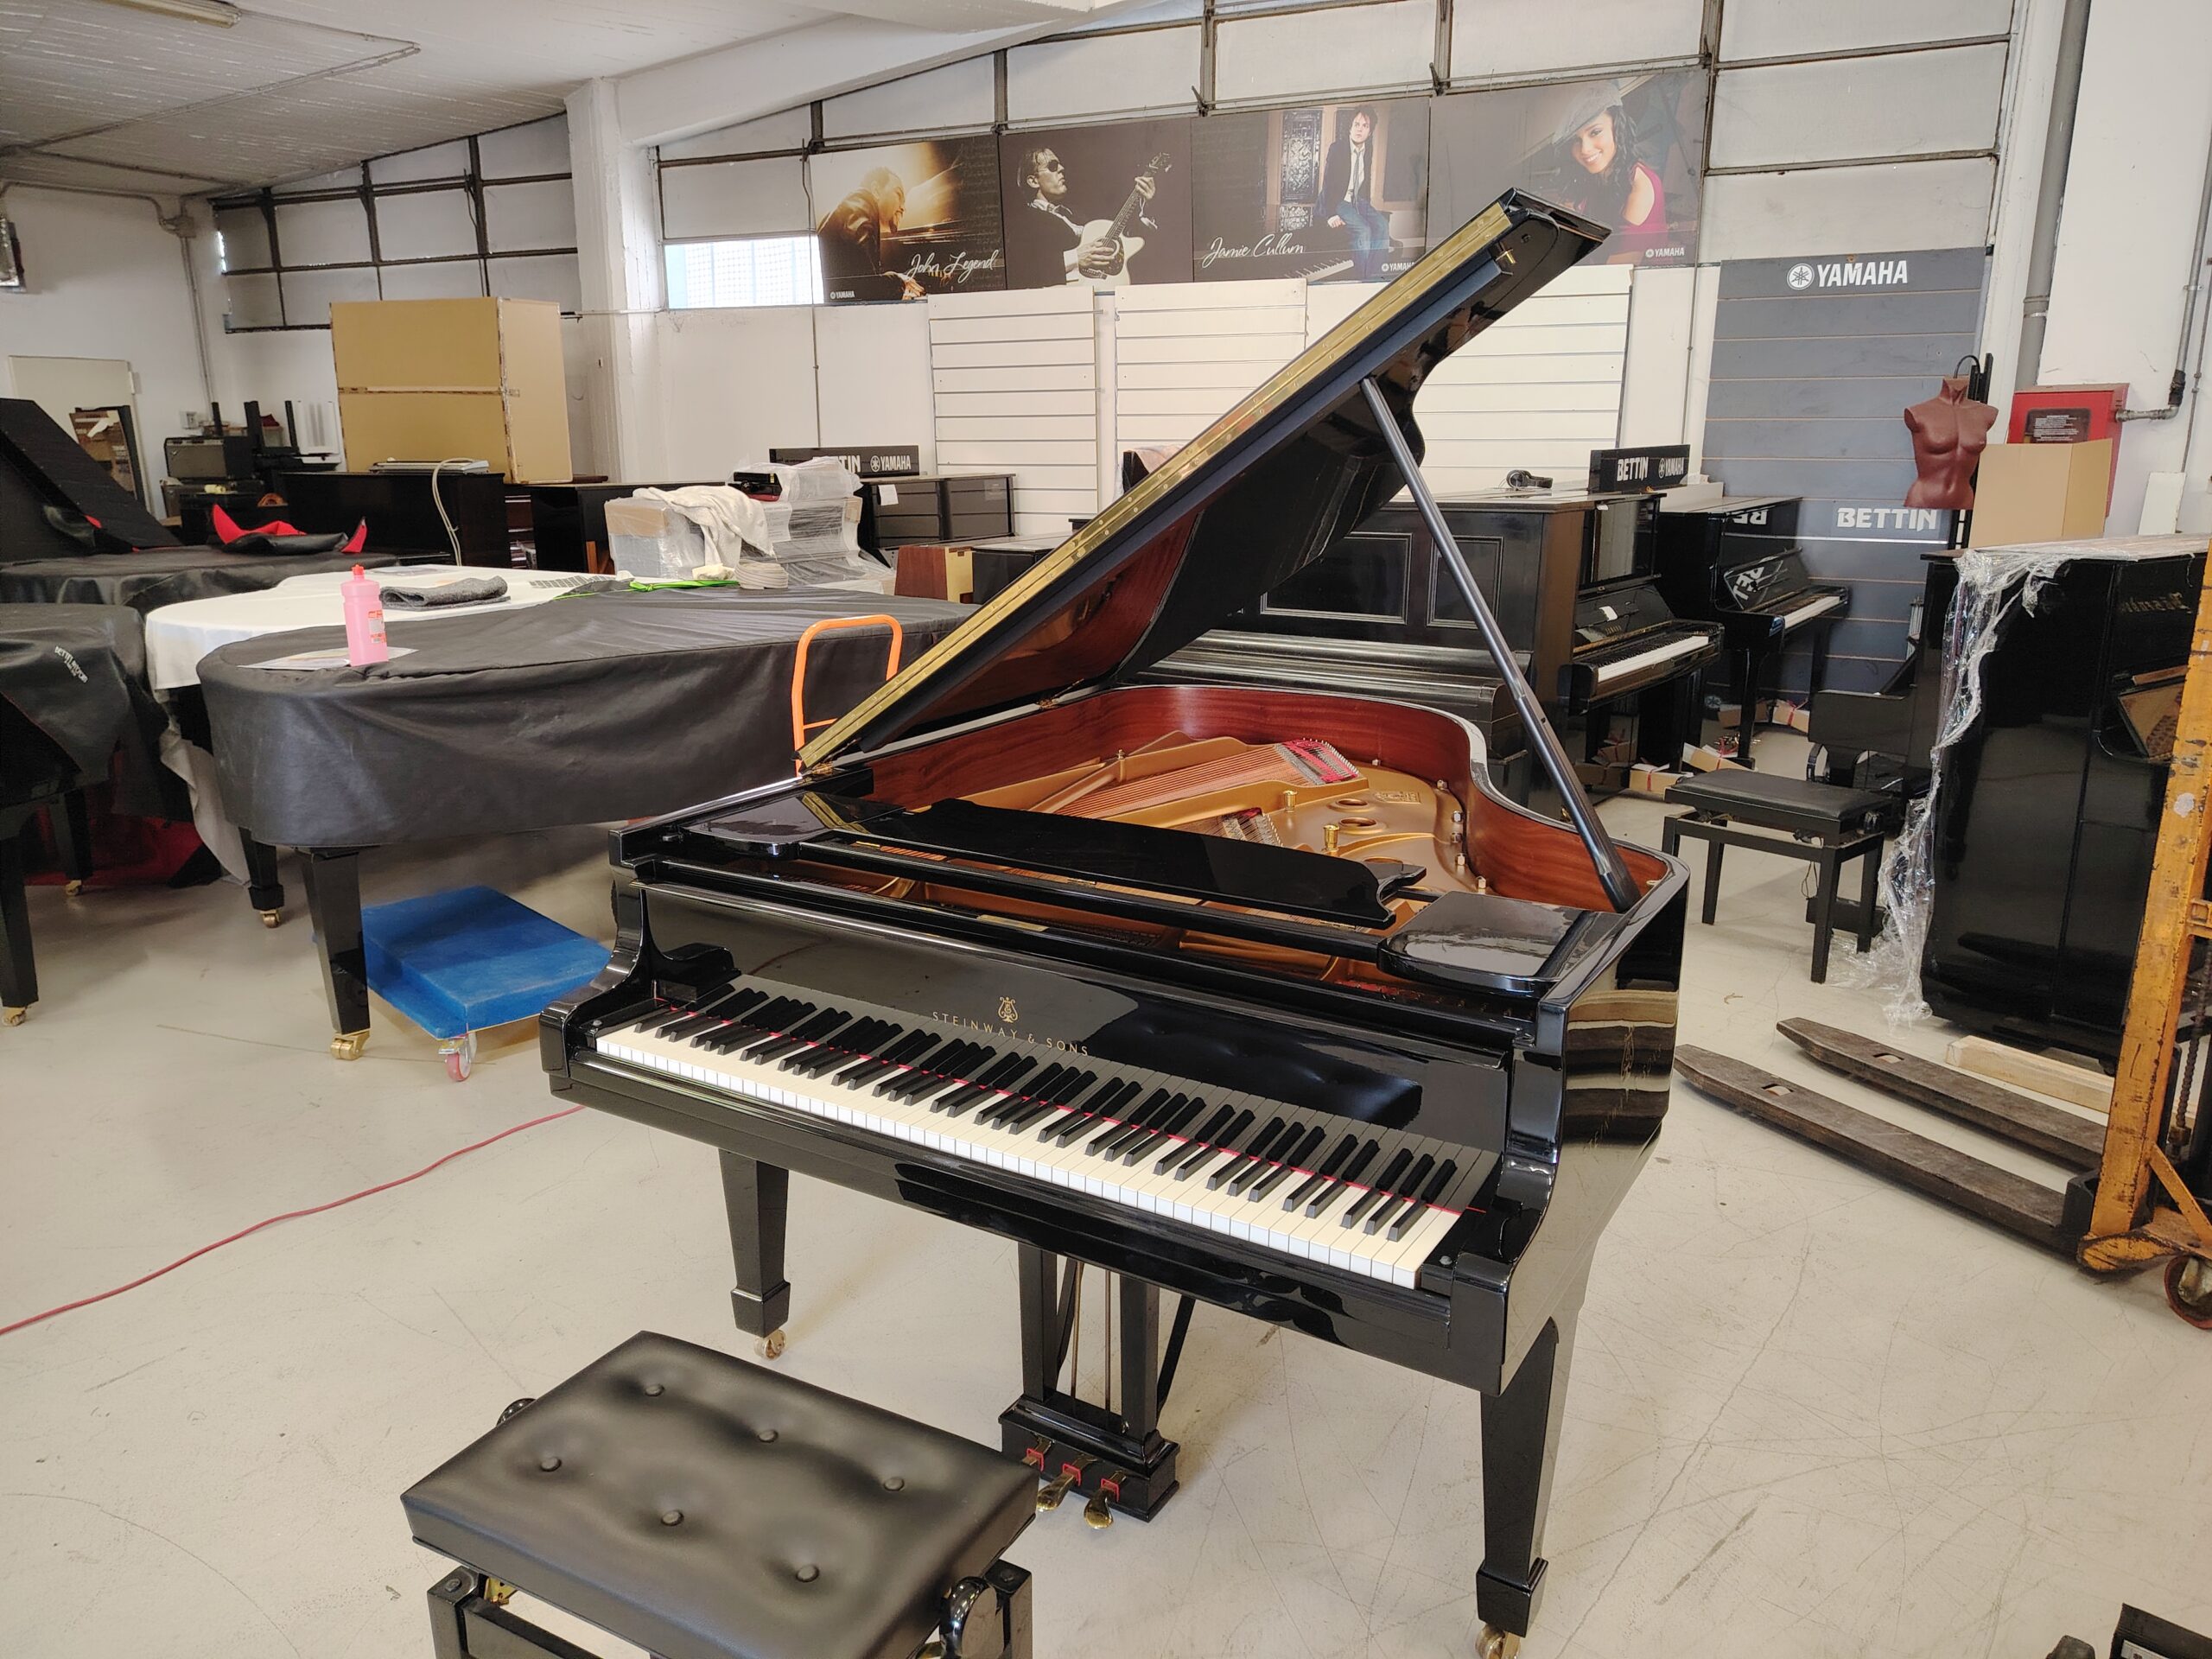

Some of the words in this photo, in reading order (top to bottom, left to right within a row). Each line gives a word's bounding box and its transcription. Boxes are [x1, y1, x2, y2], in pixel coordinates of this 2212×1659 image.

[1202, 237, 1251, 268] Jamie
[1252, 233, 1305, 257] Cullum
[1655, 247, 1684, 257] YAMAHA
[907, 252, 939, 280] John
[944, 249, 999, 283] Legend
[1817, 260, 1908, 287] YAMAHA
[836, 290, 855, 299] YAMAHA
[880, 455, 912, 471] YAMAHA
[1617, 456, 1649, 481] BETTIN
[1665, 457, 1684, 477] YAMAHA
[1837, 507, 1937, 531] BETTIN
[933, 1012, 1018, 1039] STEINWAY
[1028, 1033, 1035, 1044] &
[1046, 1038, 1088, 1056] SONS
